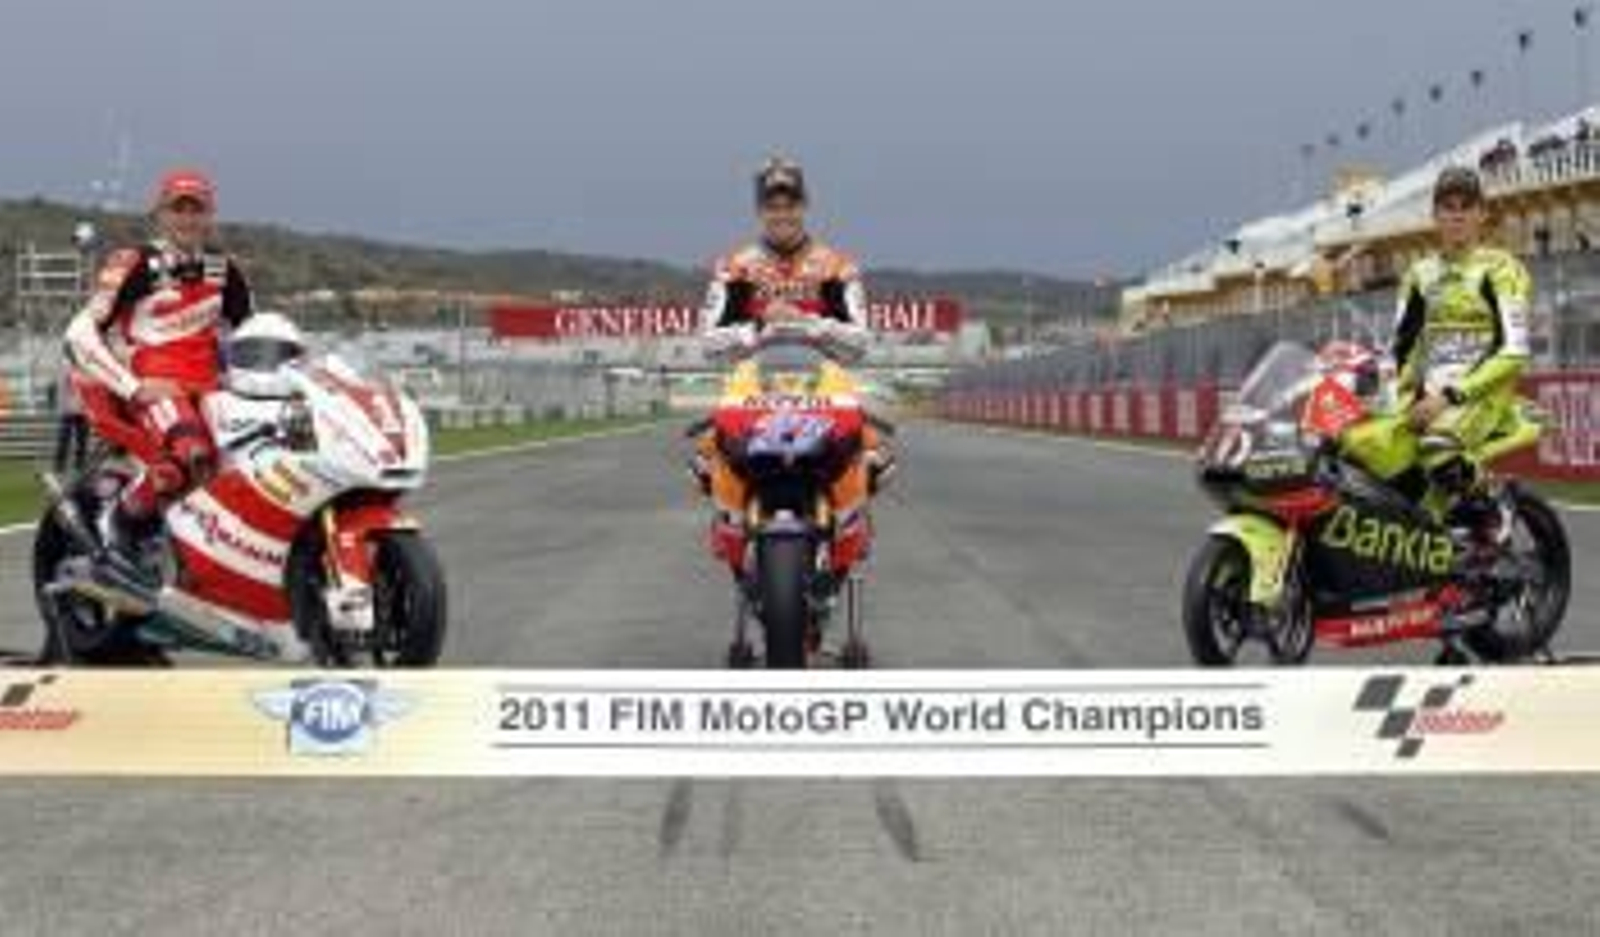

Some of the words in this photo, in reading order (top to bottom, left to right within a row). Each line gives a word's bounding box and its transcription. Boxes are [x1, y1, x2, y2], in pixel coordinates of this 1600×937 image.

[304, 698, 362, 731] FIM
[500, 699, 590, 731] 2011
[610, 700, 683, 731] FIM
[701, 700, 868, 732] MotoGP
[883, 700, 1006, 731] World
[1022, 699, 1263, 735] Champions
